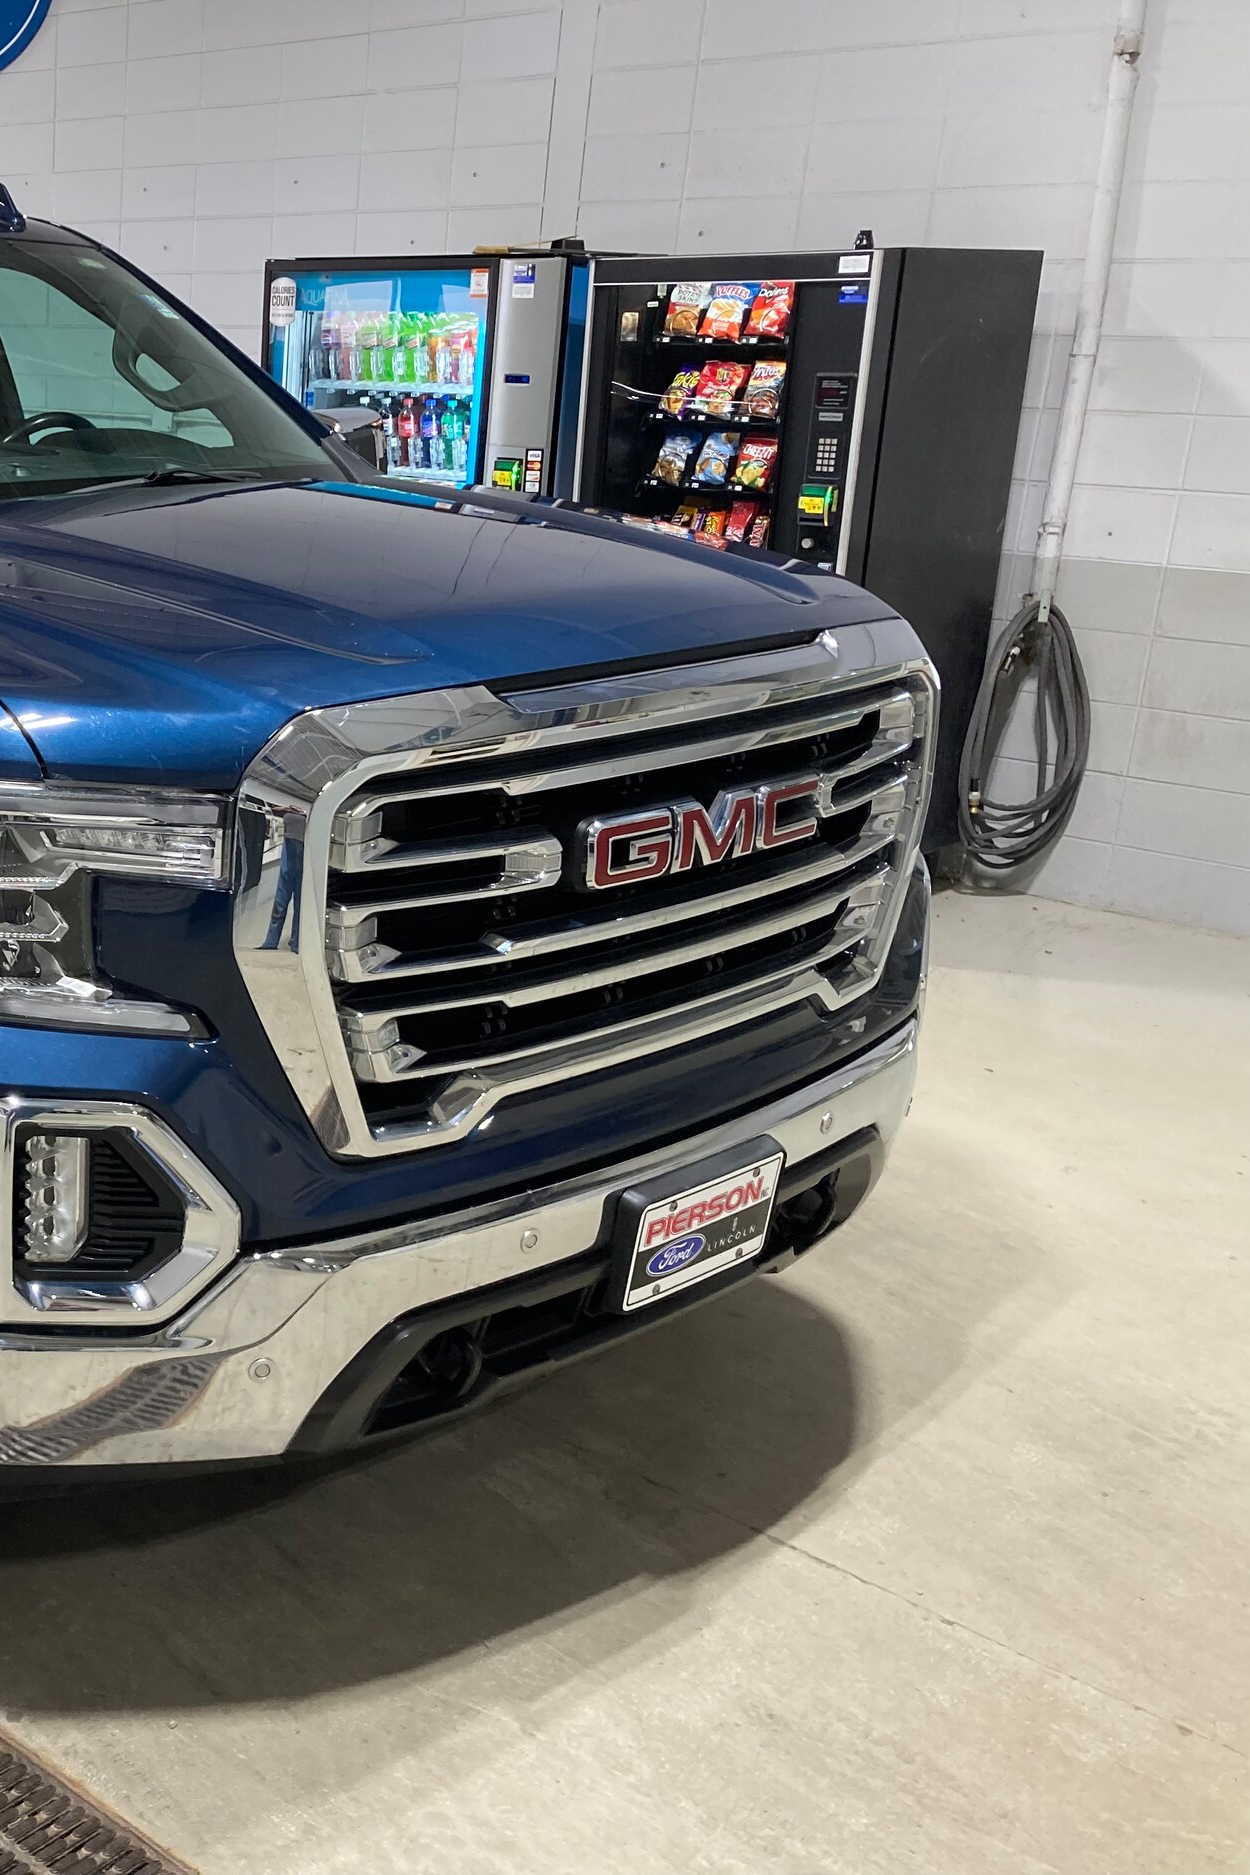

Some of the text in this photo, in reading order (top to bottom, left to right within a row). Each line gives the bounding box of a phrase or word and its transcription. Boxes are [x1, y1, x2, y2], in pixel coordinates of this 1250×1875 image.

[271, 295, 295, 307] COUNT
[272, 286, 295, 295] CALORIES
[586, 776, 818, 889] GMC
[644, 1177, 764, 1246] PIERSON
[707, 1224, 756, 1252] LINCOLN
[658, 1243, 694, 1269] Ford
